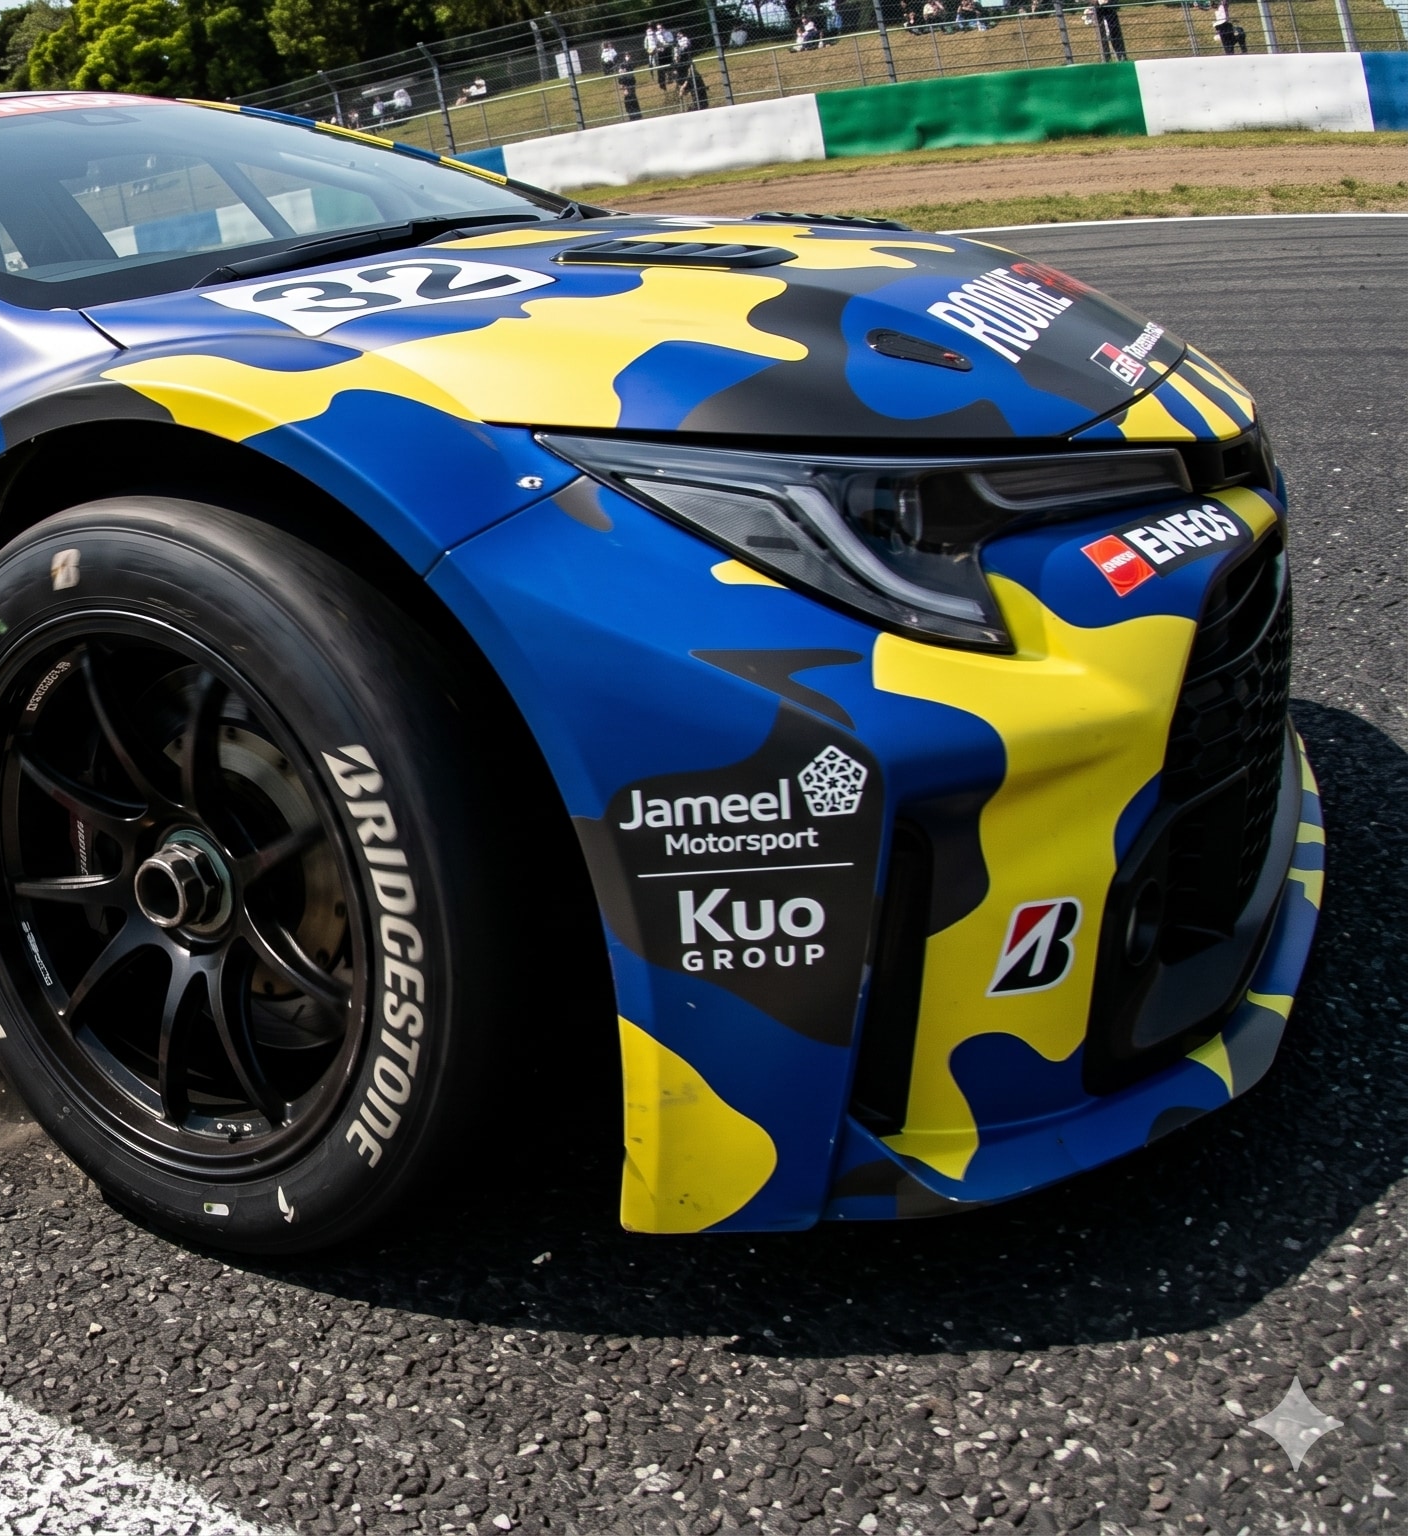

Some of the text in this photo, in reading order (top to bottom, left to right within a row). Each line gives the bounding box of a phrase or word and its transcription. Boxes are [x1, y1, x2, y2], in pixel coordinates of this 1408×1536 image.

[252, 263, 521, 312] 32
[926, 267, 1074, 364] ROOKIE
[1123, 504, 1239, 565] ENEOS
[619, 778, 791, 830] Jameel
[665, 827, 819, 856] Motorsport
[682, 944, 825, 971] GROUP
